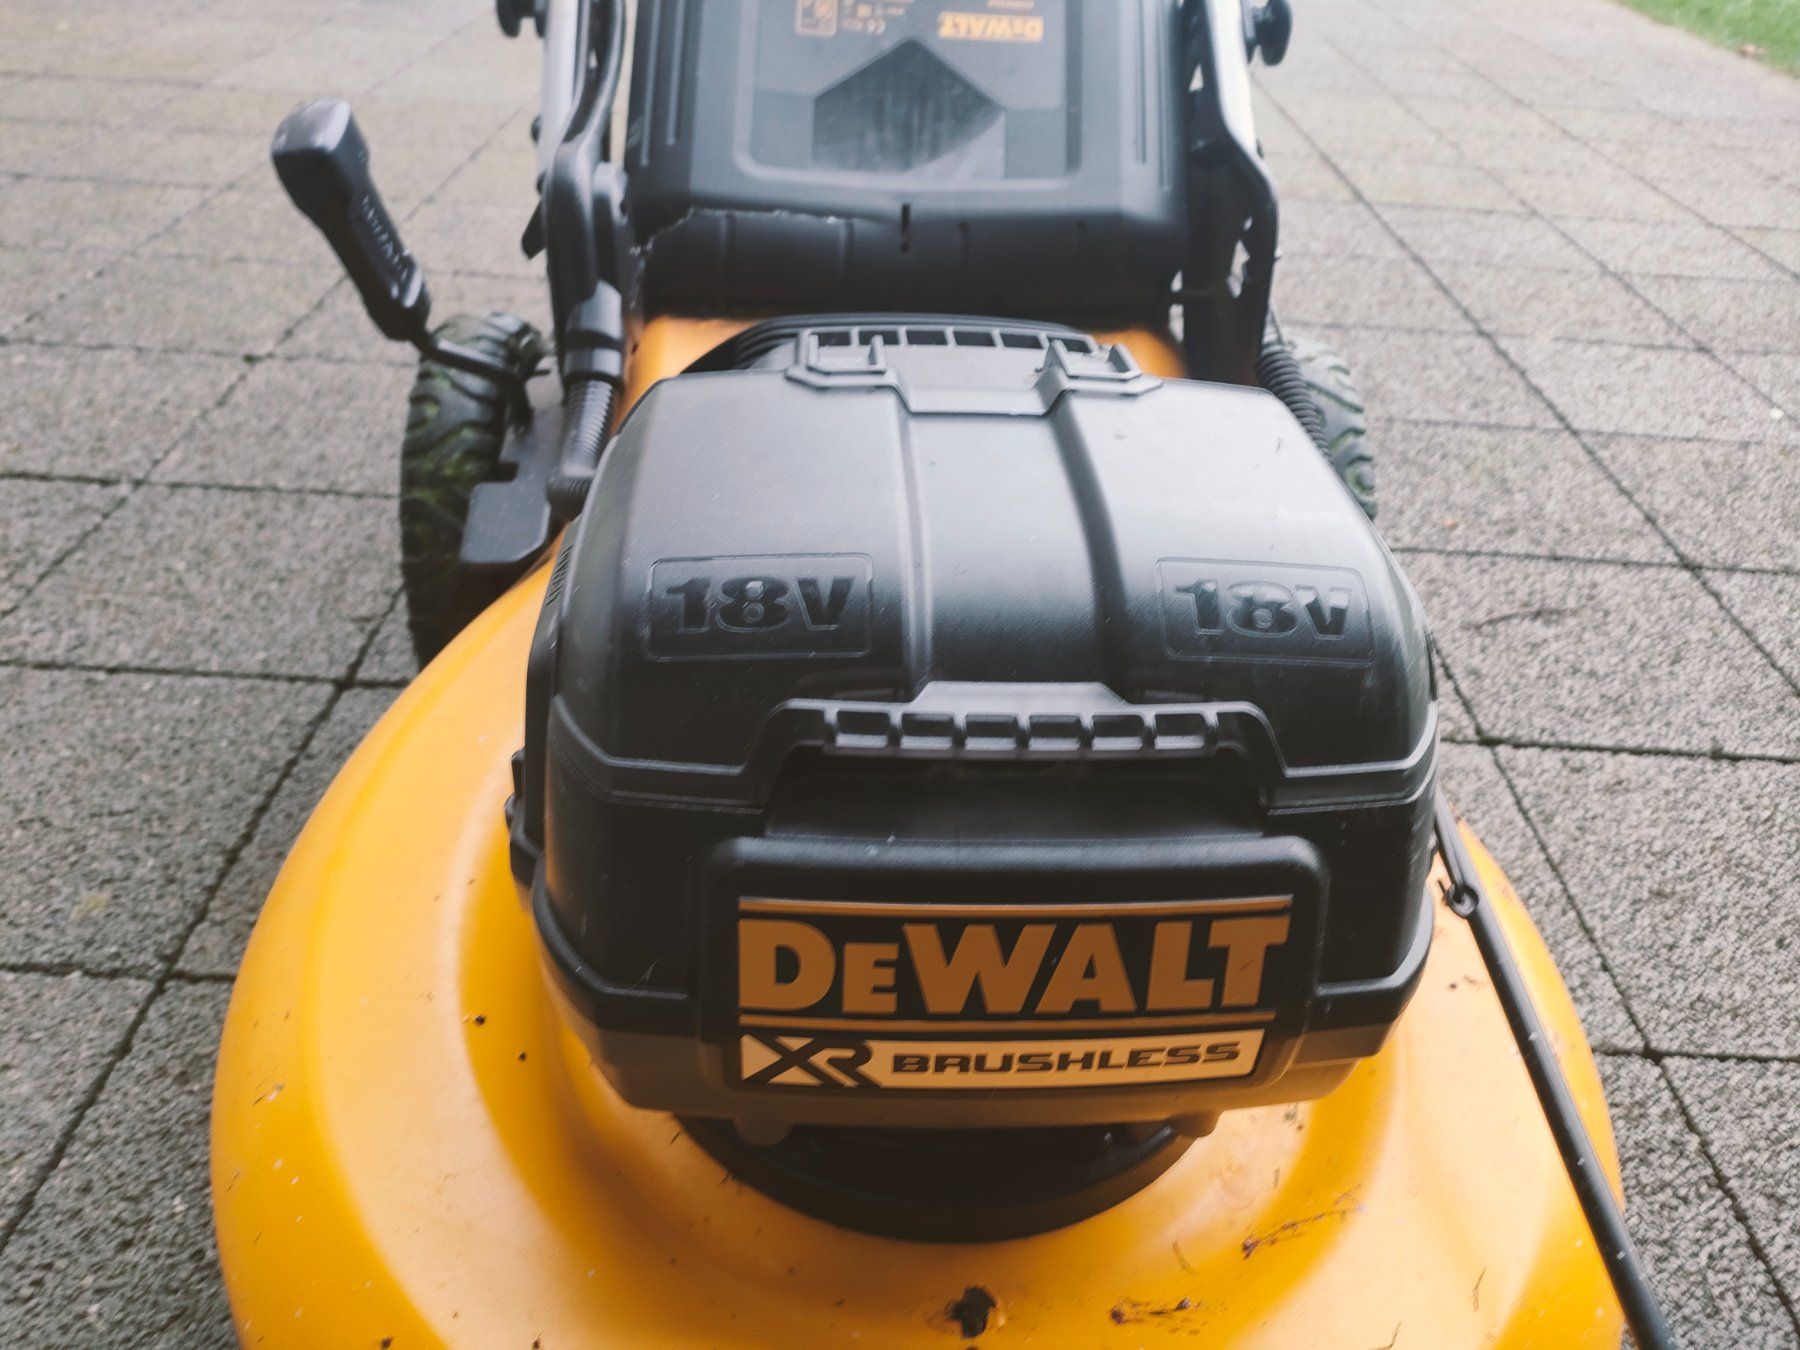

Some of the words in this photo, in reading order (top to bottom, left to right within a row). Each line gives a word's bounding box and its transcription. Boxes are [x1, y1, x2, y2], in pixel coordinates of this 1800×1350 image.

[667, 576, 855, 634] 18V
[1175, 578, 1352, 641] 18V
[744, 1034, 883, 1088] XR
[892, 1040, 1241, 1075] BRUSHLESS
